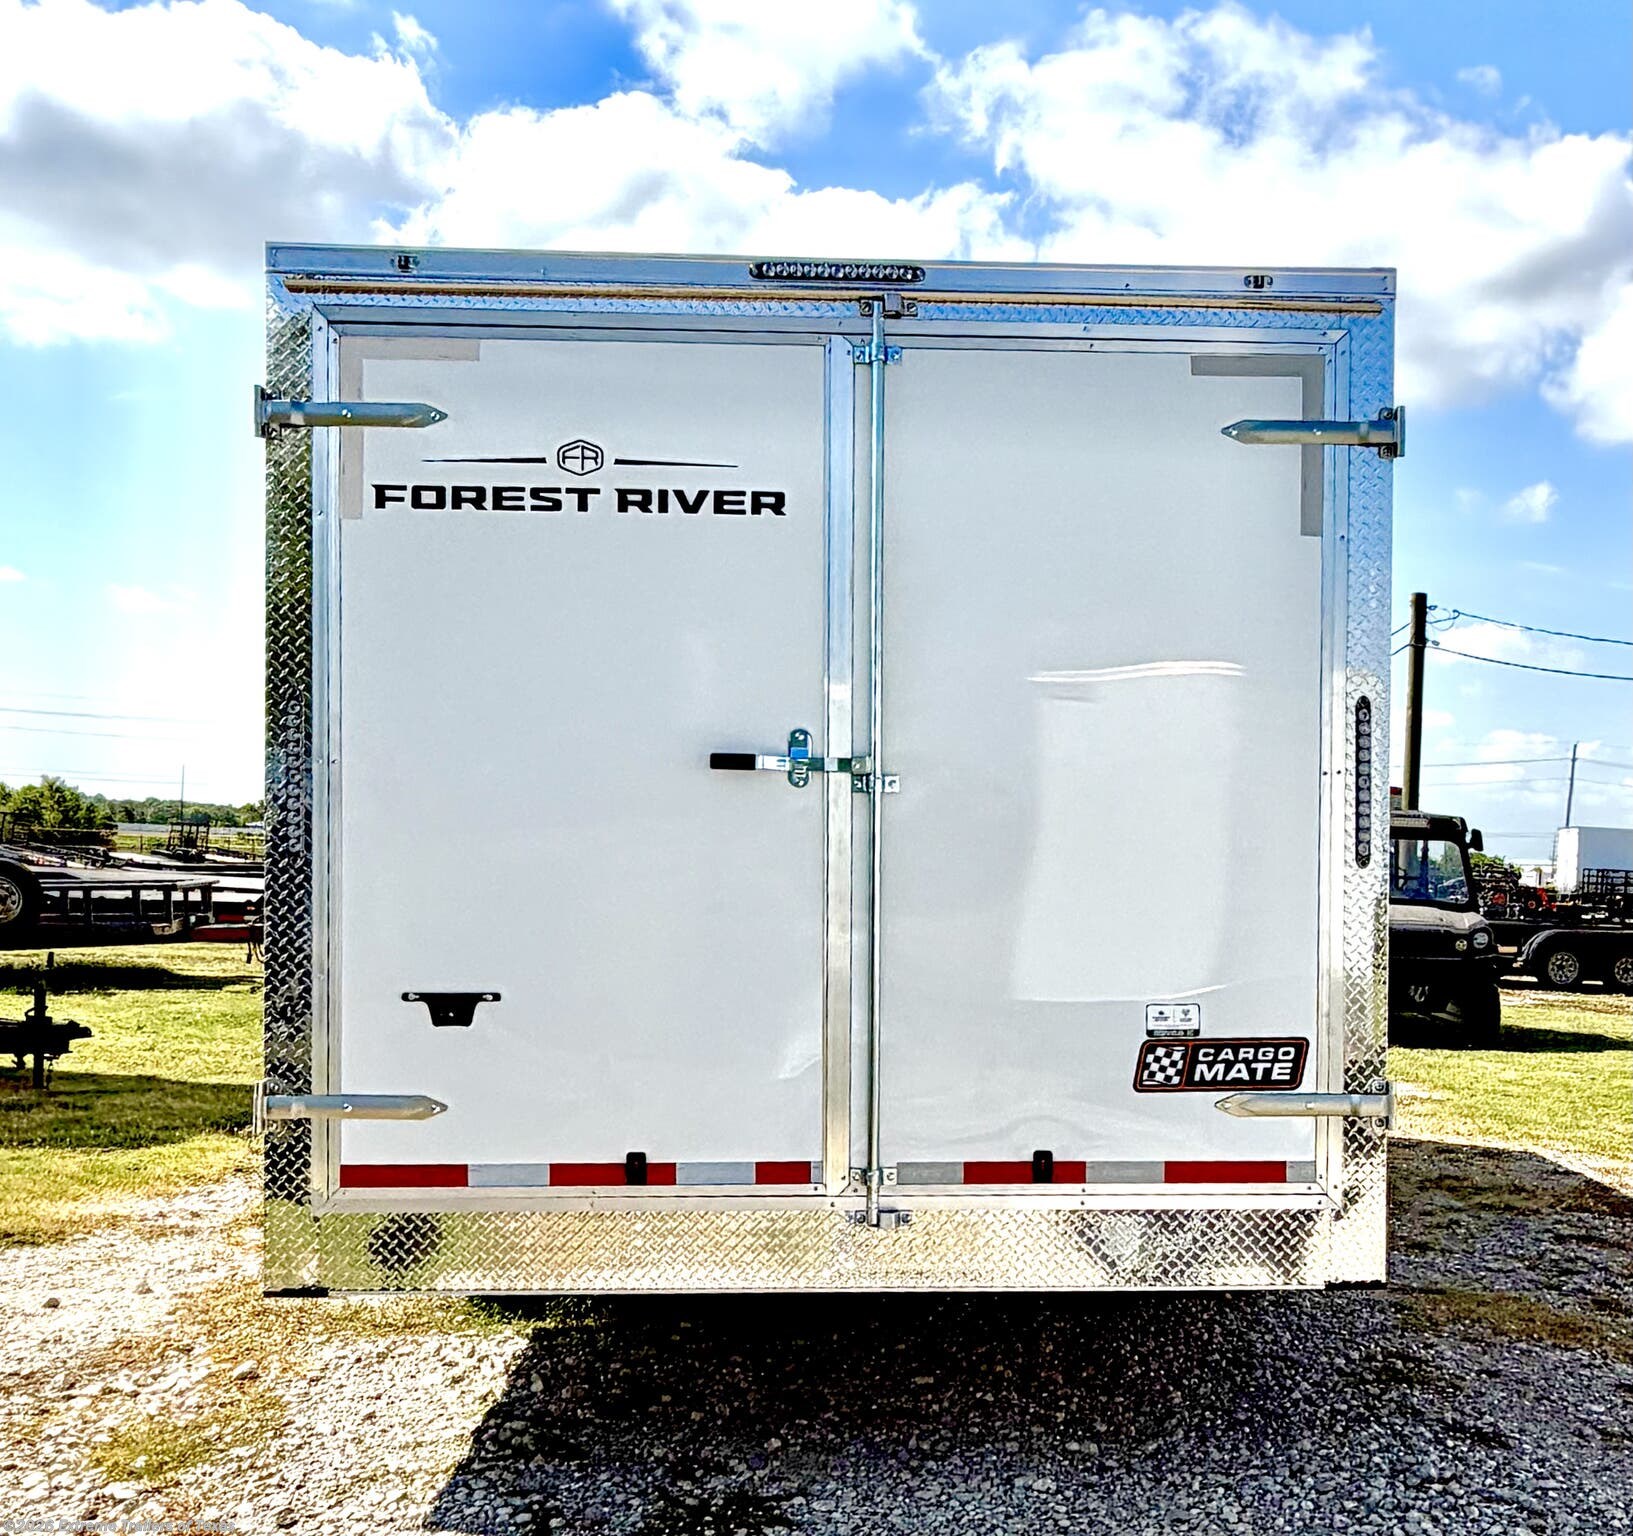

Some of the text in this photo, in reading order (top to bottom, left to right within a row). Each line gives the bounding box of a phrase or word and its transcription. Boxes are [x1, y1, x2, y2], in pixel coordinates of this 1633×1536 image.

[561, 445, 600, 471] FR
[371, 484, 787, 516] FOREST RIVER
[1197, 1047, 1295, 1062] CARGO
[1193, 1063, 1293, 1082] MATE
